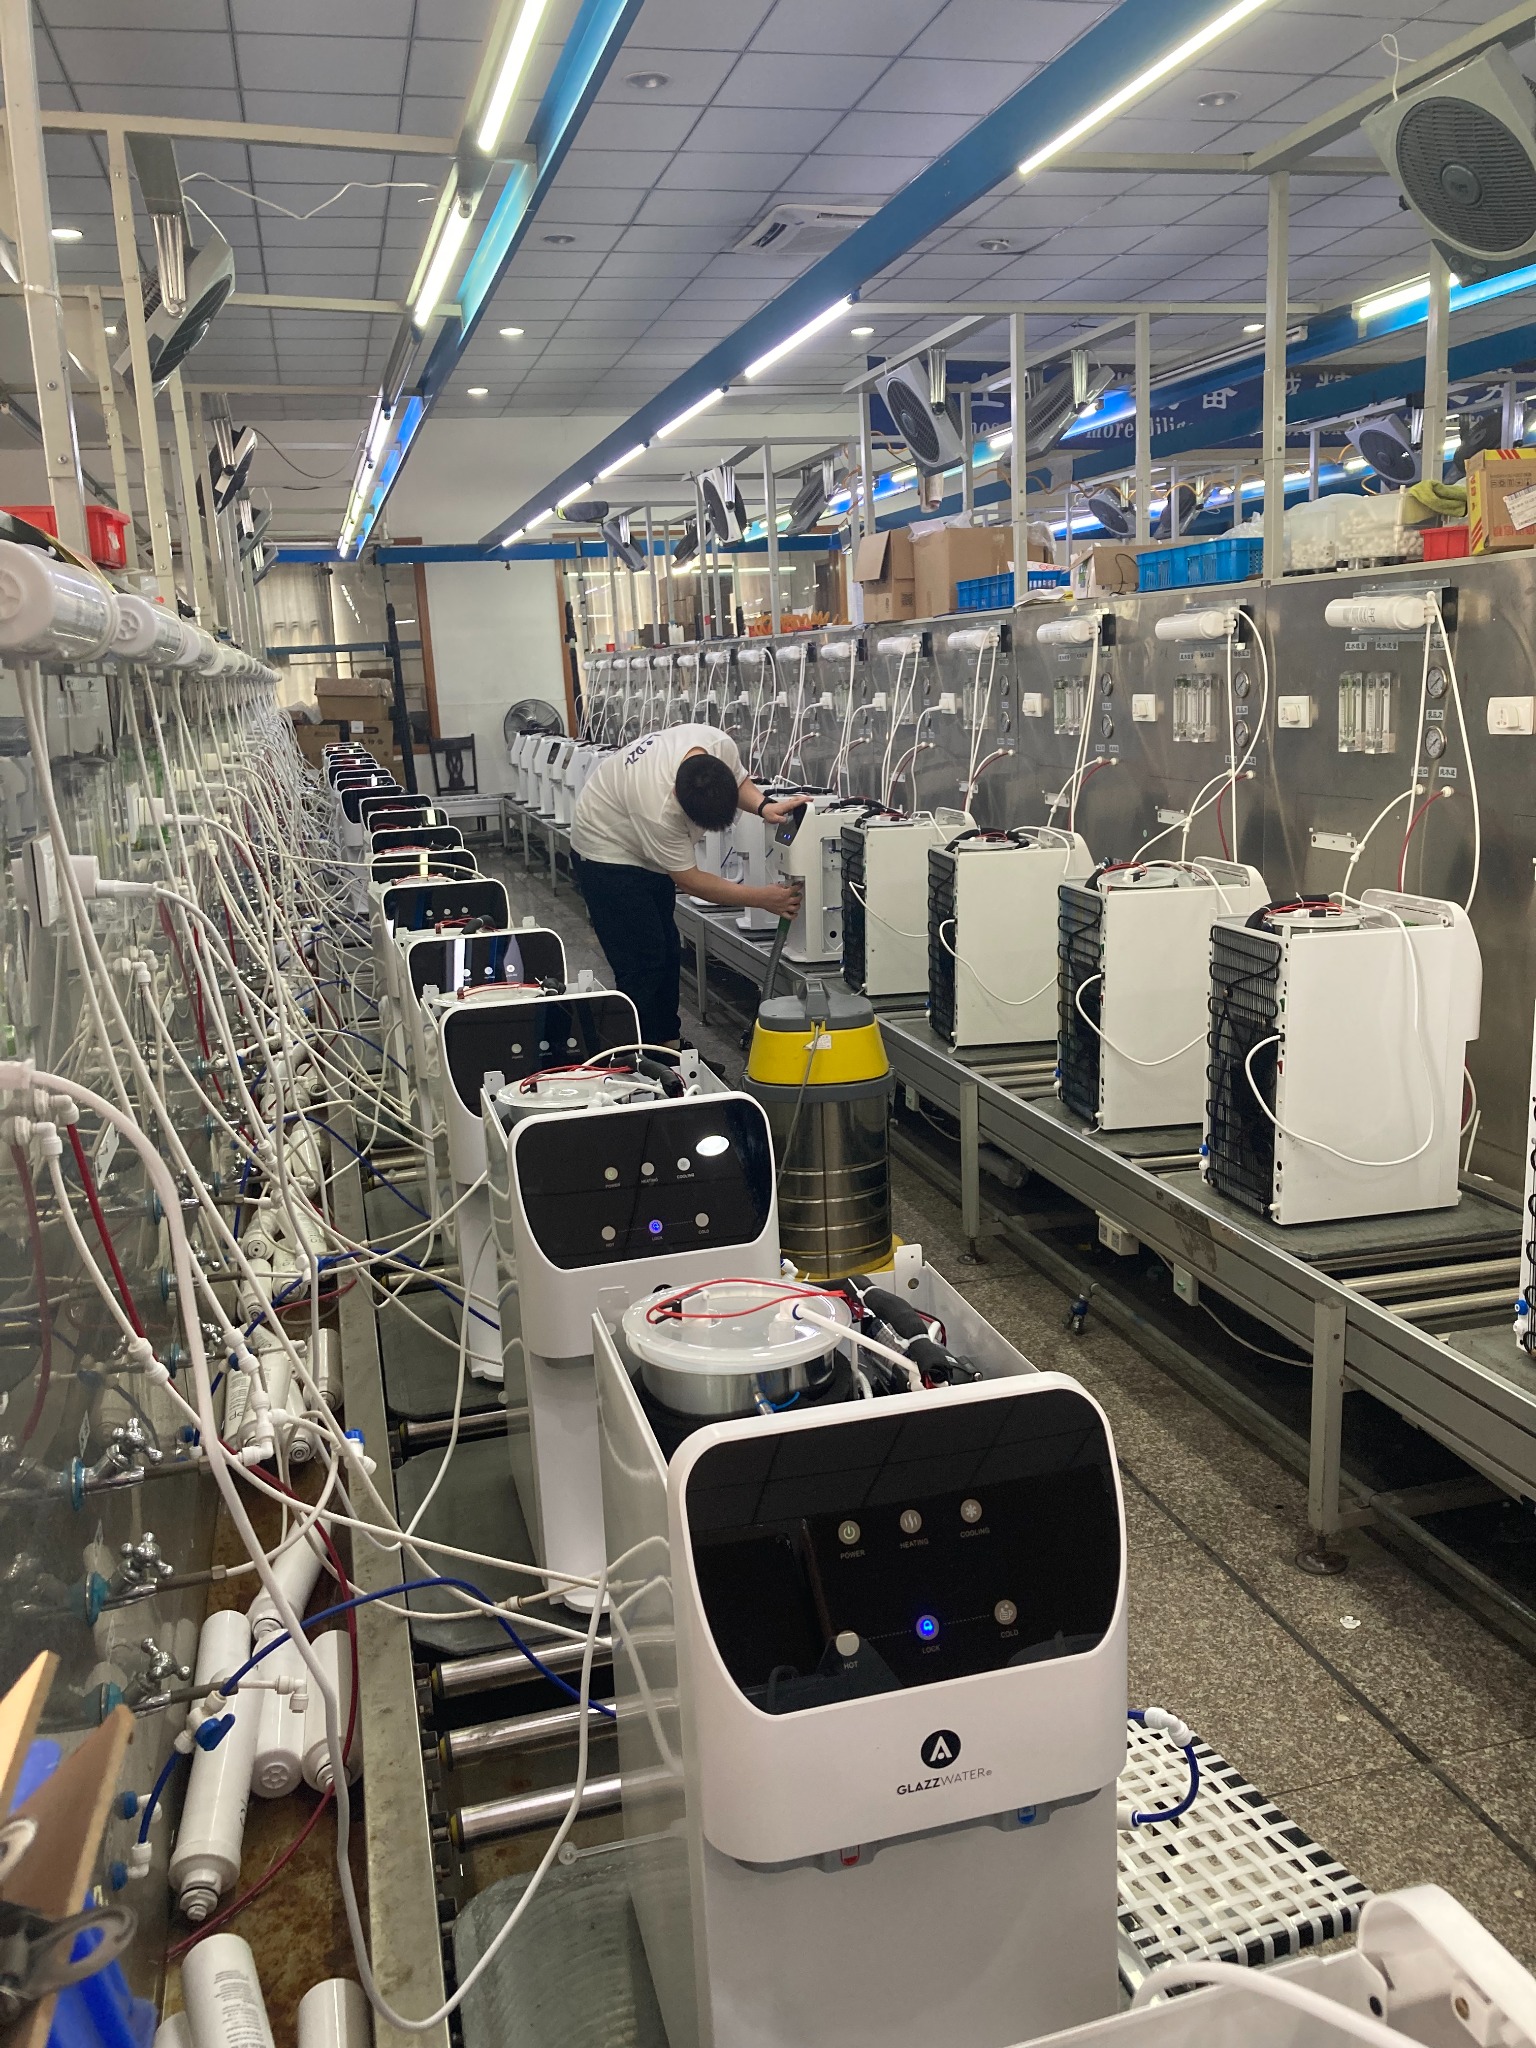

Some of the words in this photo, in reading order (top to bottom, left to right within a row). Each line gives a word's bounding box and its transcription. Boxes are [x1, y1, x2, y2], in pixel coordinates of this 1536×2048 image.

[840, 1549, 866, 1560] POWER
[899, 1537, 930, 1550] HEATING
[960, 1526, 991, 1538] COOLING
[843, 1660, 859, 1670] HOT
[922, 1645, 941, 1655] LOCK
[1000, 1629, 1019, 1639] COLD
